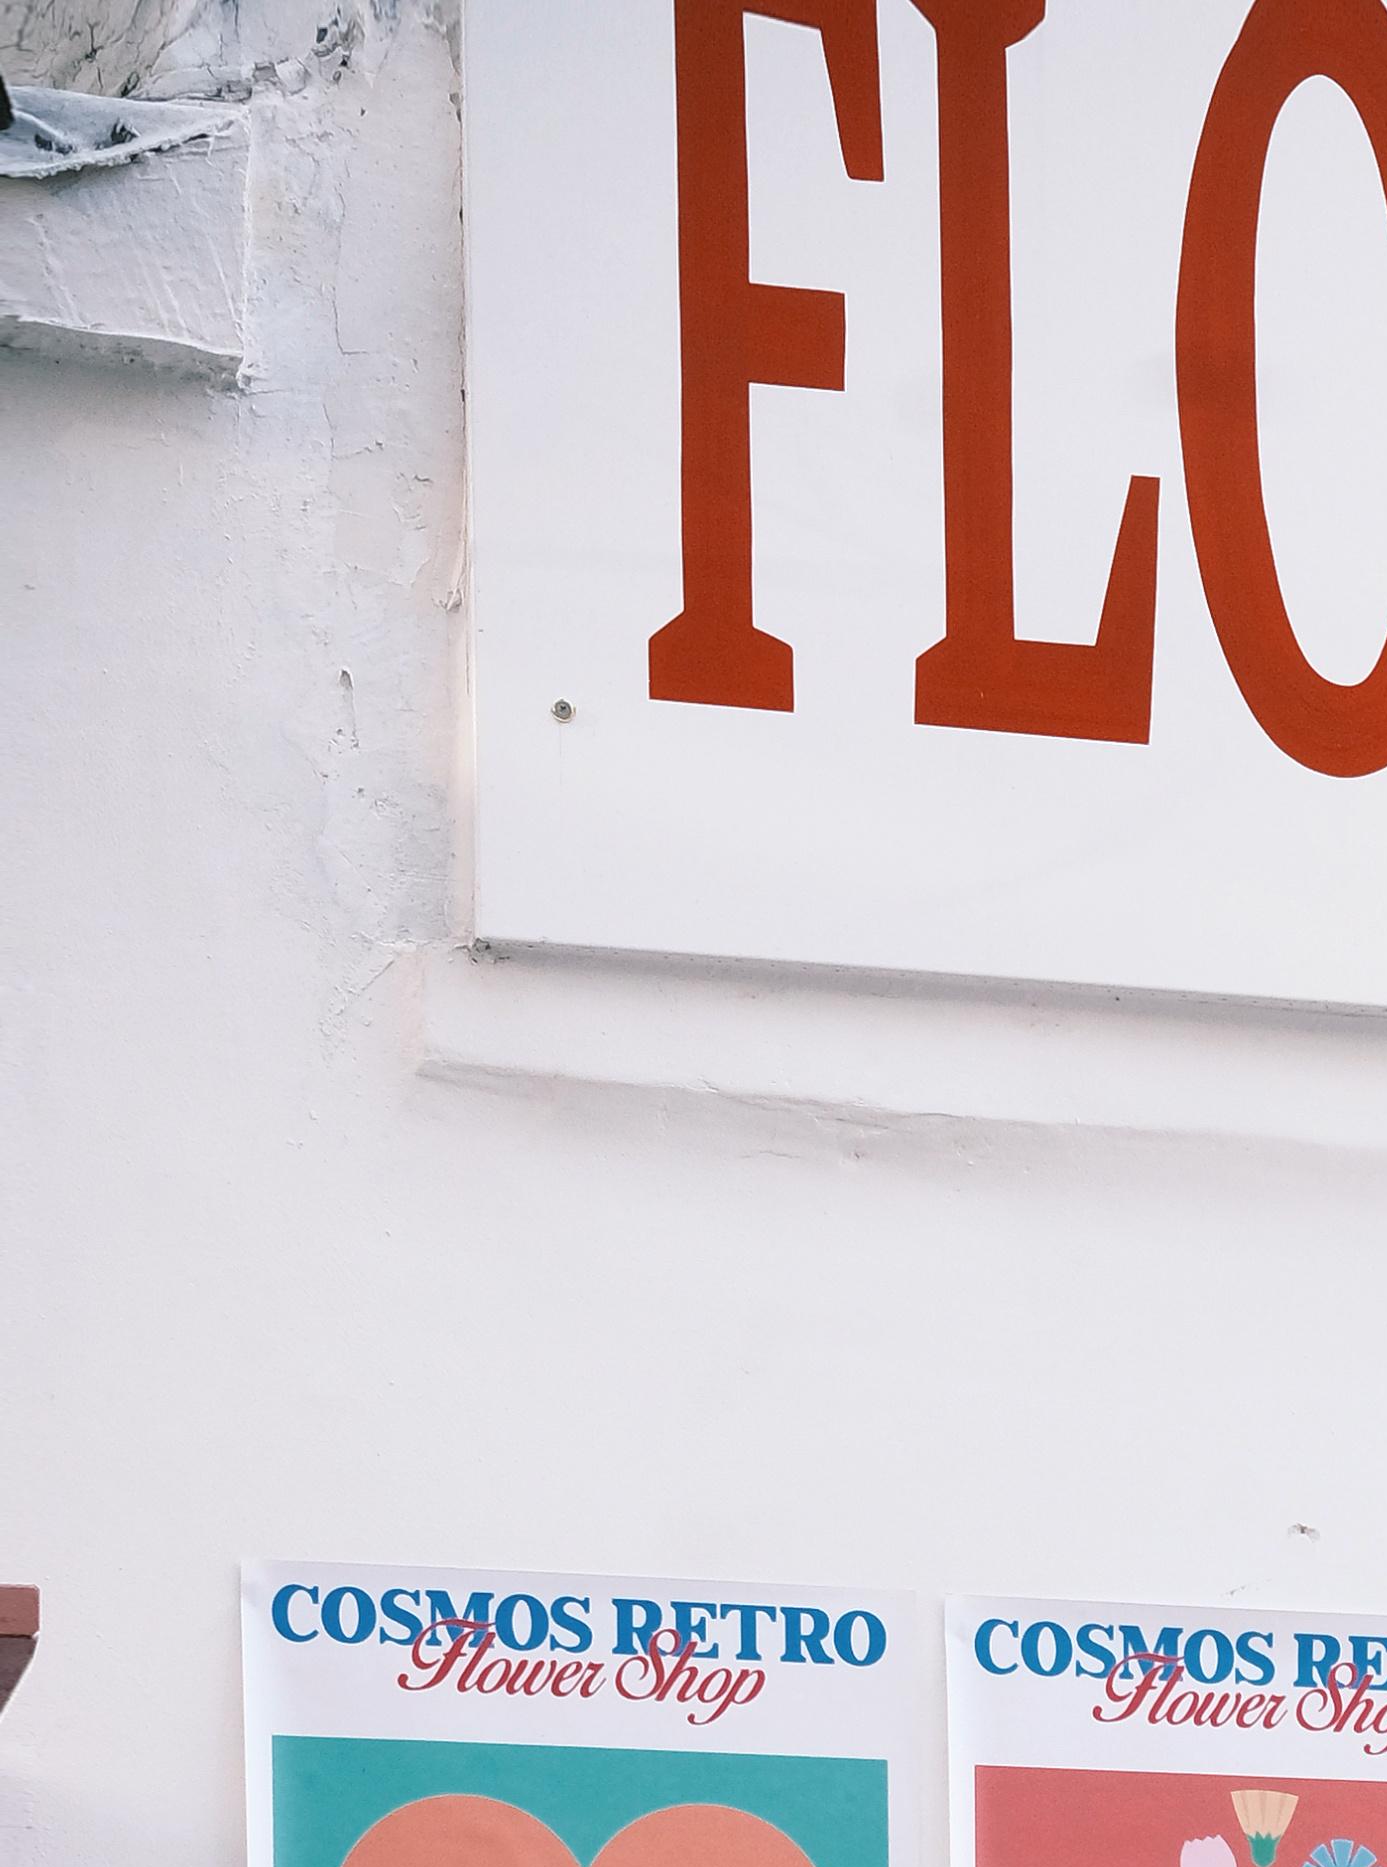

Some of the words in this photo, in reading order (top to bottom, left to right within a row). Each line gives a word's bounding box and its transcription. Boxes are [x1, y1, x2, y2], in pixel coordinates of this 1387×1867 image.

[271, 1584, 592, 1653] COSMOS
[612, 1598, 887, 1667] RETRO
[974, 1618, 1275, 1686] COSMOS
[397, 1618, 603, 1697] Flower
[615, 1628, 766, 1724] Shop
[1092, 1653, 1285, 1728] Flower
